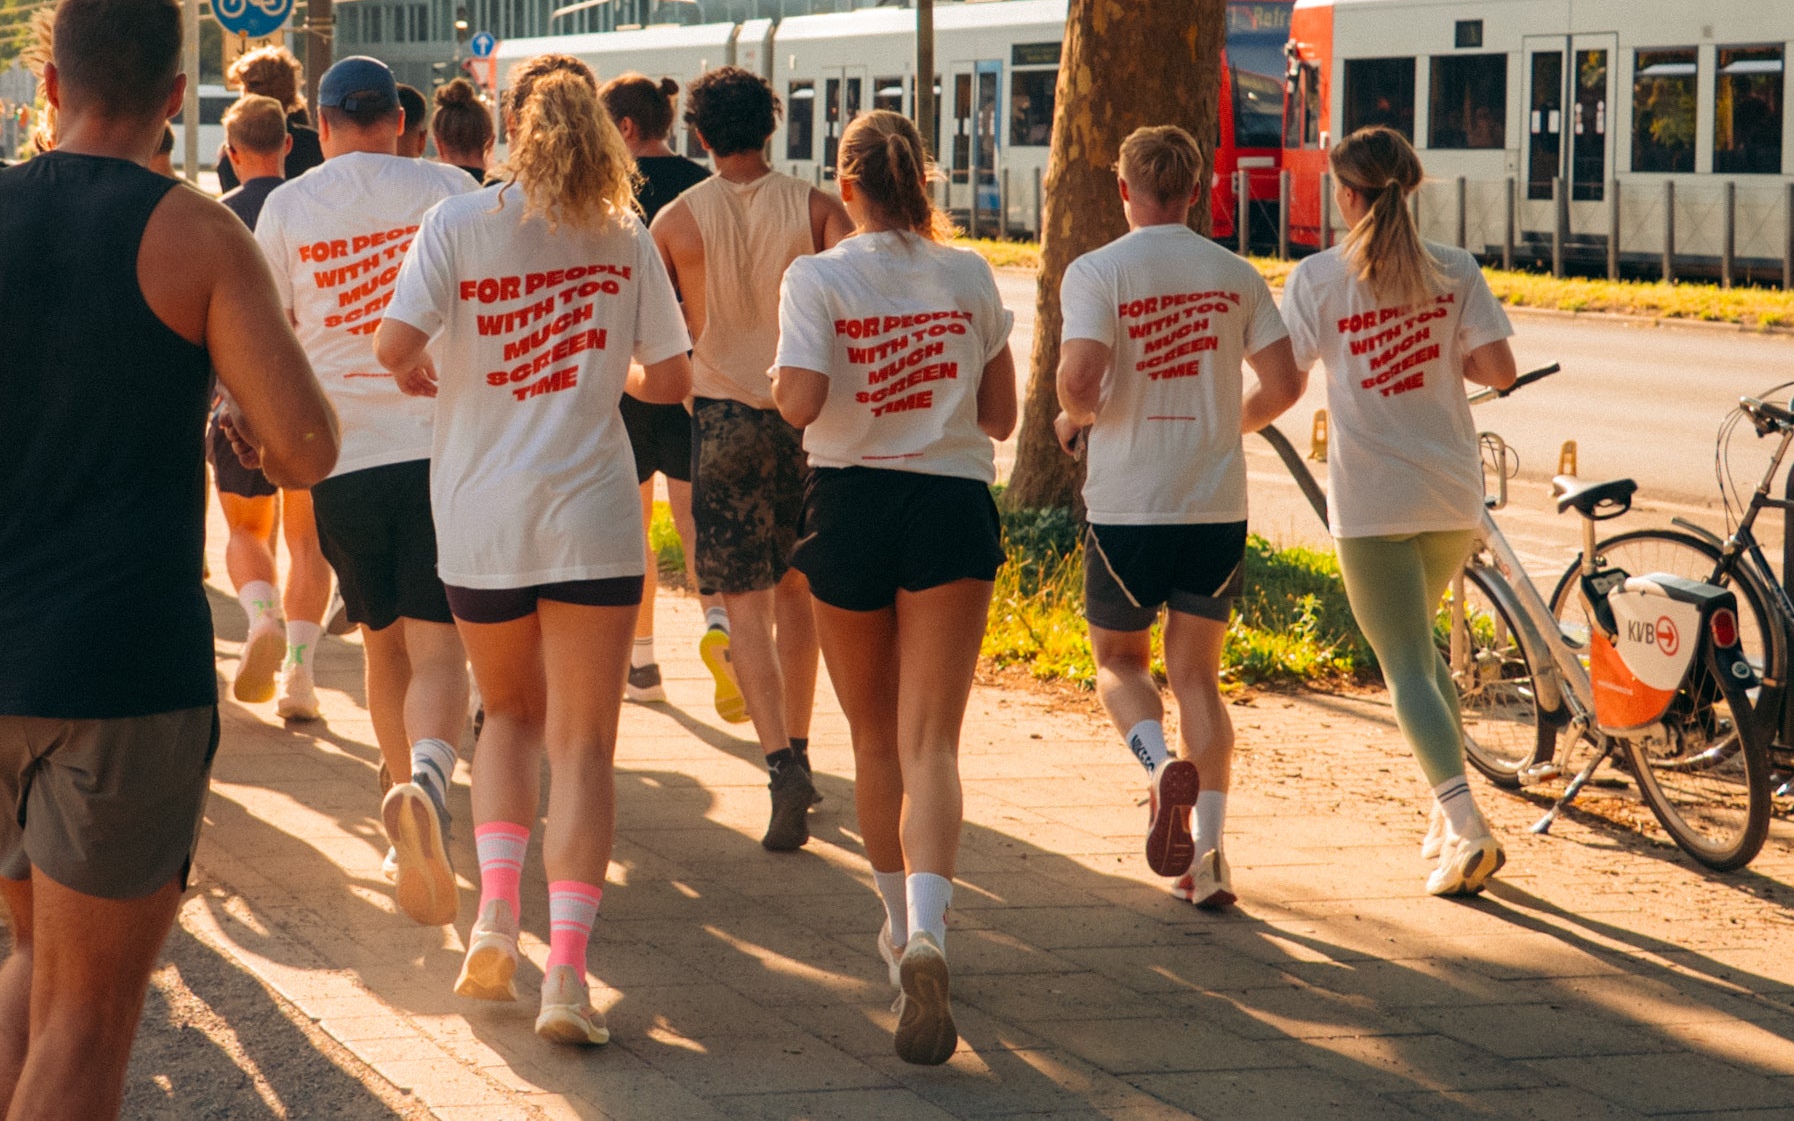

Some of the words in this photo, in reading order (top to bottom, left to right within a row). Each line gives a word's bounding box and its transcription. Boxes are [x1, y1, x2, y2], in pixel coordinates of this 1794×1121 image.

[1254, 5, 1292, 27] Refr
[299, 240, 348, 262] FOR
[352, 225, 419, 254] PEOP
[314, 253, 379, 288] WITH
[383, 239, 413, 260] TO
[339, 262, 402, 307] MUC
[460, 276, 521, 303] FOR
[525, 265, 632, 295] PEOPLE
[324, 289, 394, 328] SCRE
[476, 296, 555, 336] WITH
[558, 279, 619, 304] TOO
[1119, 297, 1158, 318] FOR
[1161, 291, 1240, 310] PEOPLE
[1128, 312, 1179, 339] WITH
[1183, 301, 1228, 318] TOO
[1338, 311, 1376, 333] FOR
[347, 318, 382, 335] TI
[504, 303, 593, 362] MUCH
[834, 316, 880, 339] FOR
[883, 311, 973, 333] PEOPLE
[847, 335, 908, 364] WITH
[912, 323, 966, 343] TOO
[1144, 318, 1209, 354] MUCH
[1350, 324, 1401, 355] WITH
[1404, 307, 1447, 330] TOO
[486, 328, 607, 386] SCREEN
[868, 341, 944, 385] MUCH
[1136, 336, 1218, 372] SCREEN
[1361, 344, 1439, 389] SCREEN
[1370, 327, 1430, 371] MUCH
[512, 364, 579, 401] TIME
[855, 362, 957, 403] SCREEN
[1148, 360, 1199, 382] TIME
[1380, 371, 1424, 397] TIME
[871, 390, 933, 417] TIME
[1628, 620, 1655, 644] KVB
